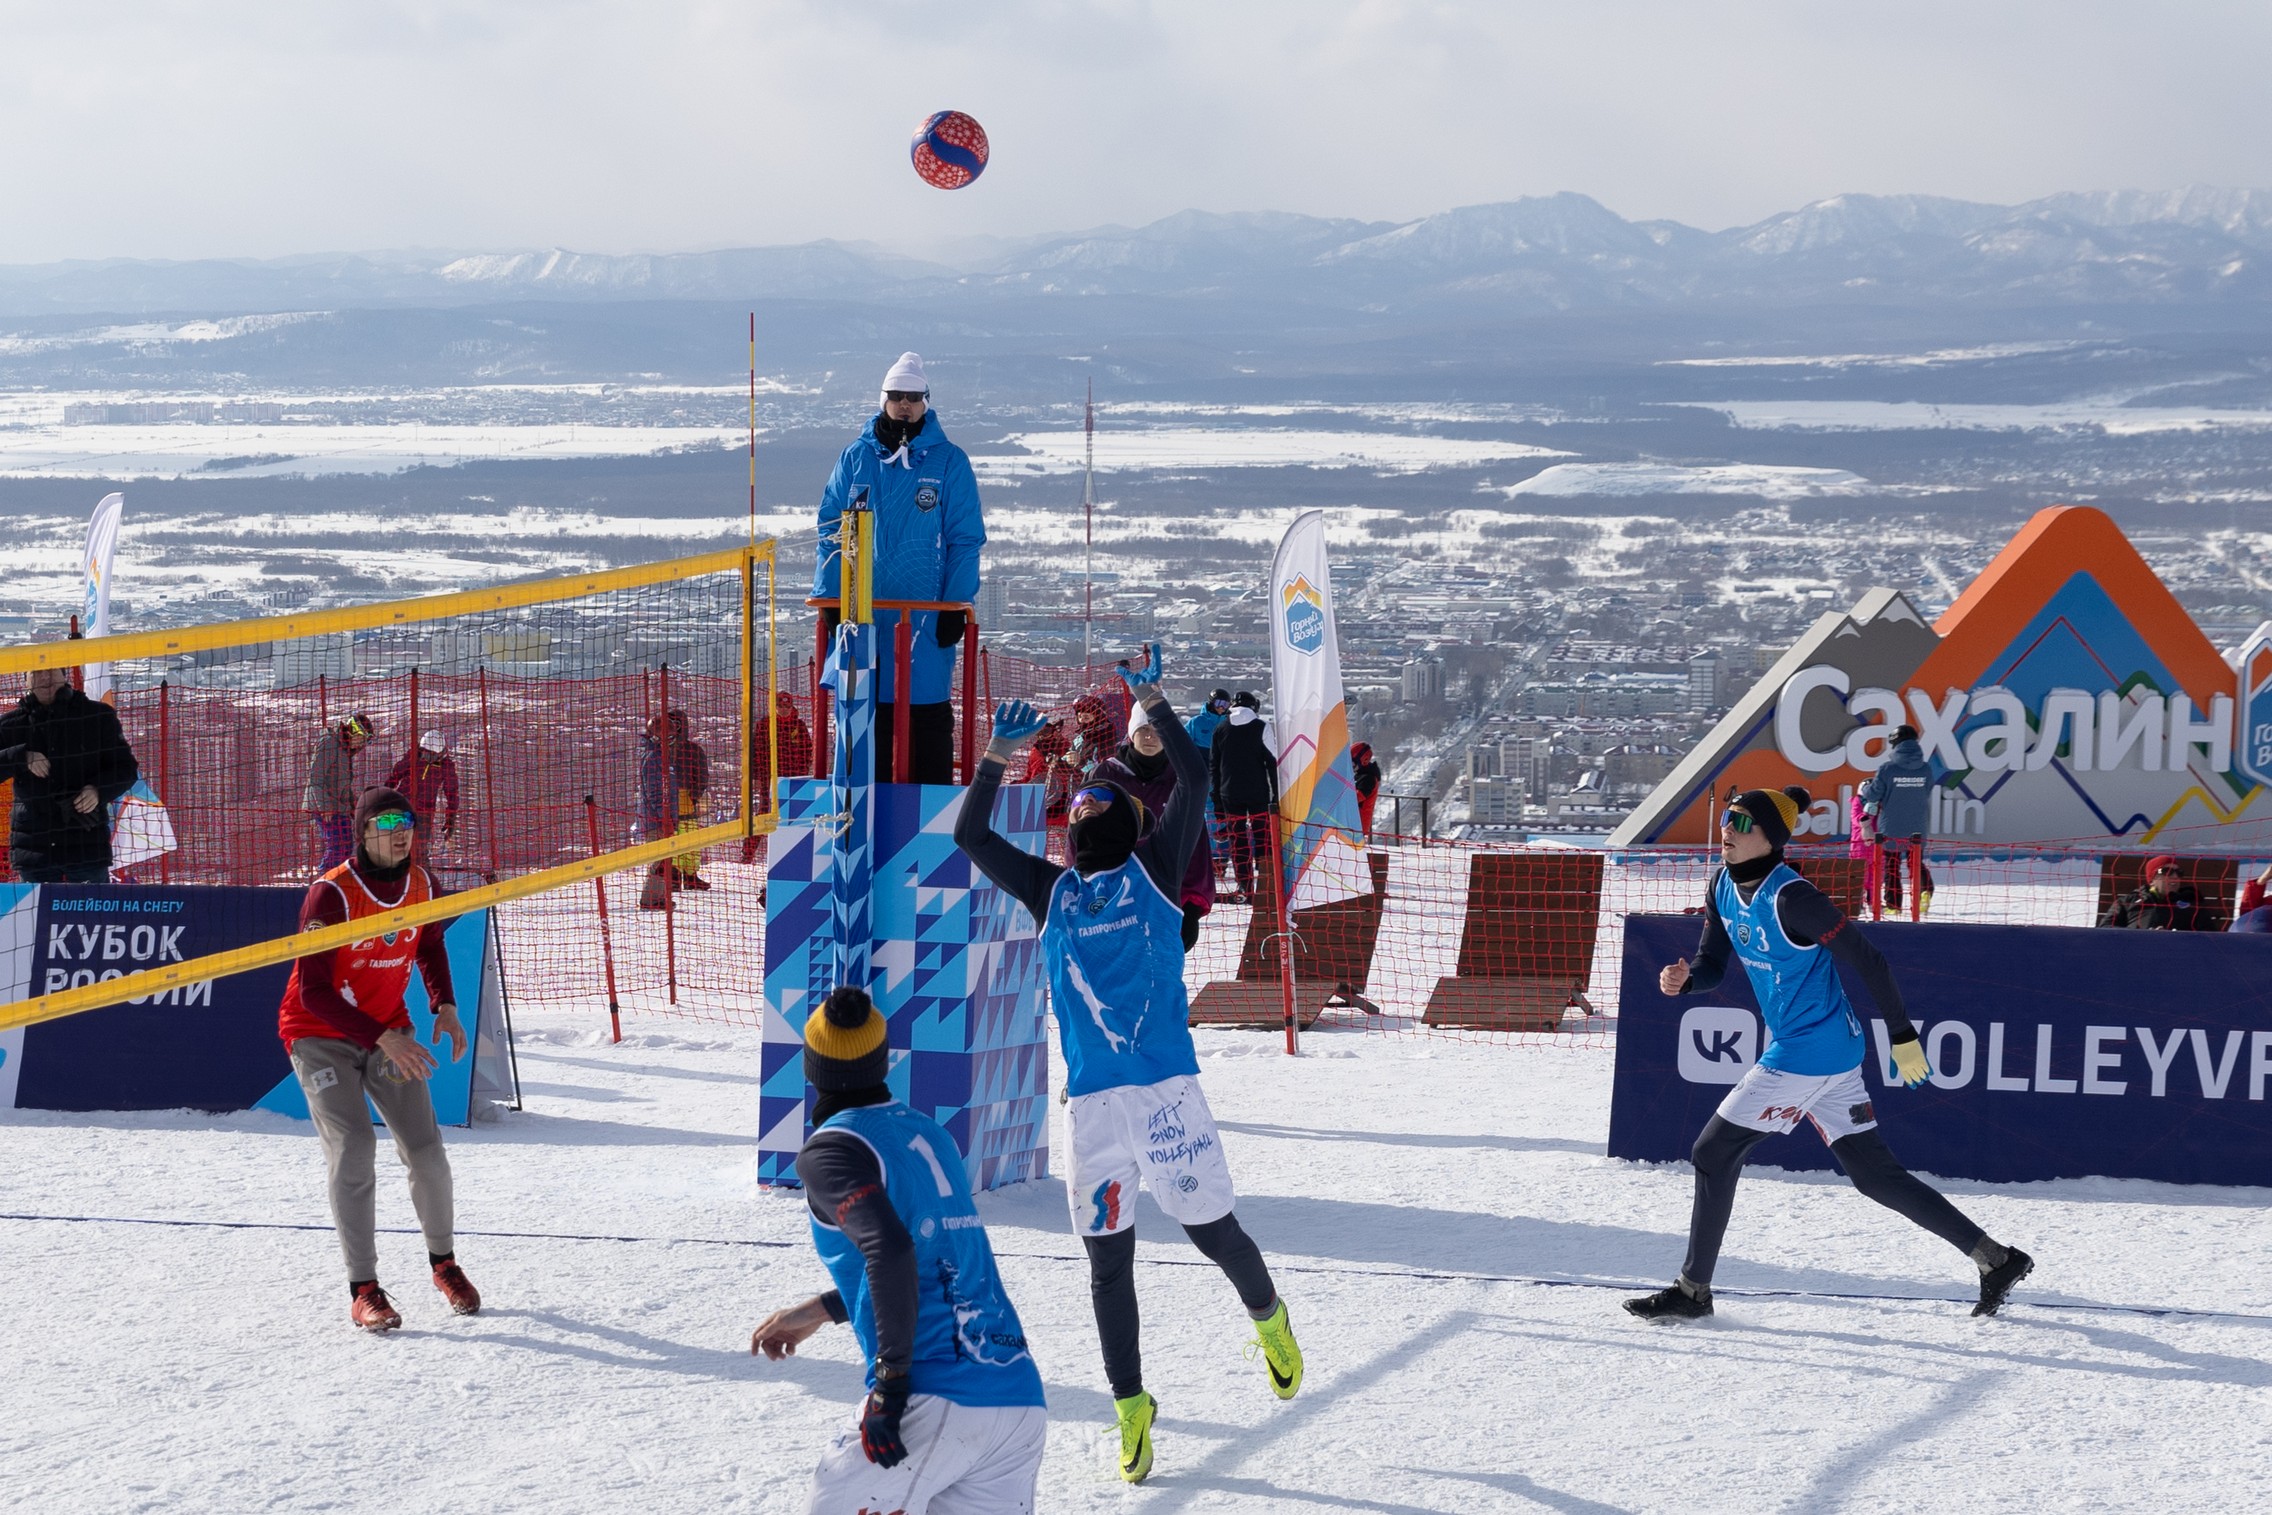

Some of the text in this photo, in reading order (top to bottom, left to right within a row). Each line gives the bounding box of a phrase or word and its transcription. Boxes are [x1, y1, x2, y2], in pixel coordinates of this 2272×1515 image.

[1775, 664, 2234, 773] Сахалин
[52, 898, 184, 913] ВОЛЕЙБОЛ НА СНЕГУ
[1117, 877, 1135, 907] 2
[47, 923, 186, 961] КУБОК
[1078, 915, 1139, 938] ГАЗПРОМБАНК
[1756, 926, 1770, 952] 3
[1692, 1029, 1743, 1064] VK
[1146, 1133, 1213, 1167] VOLLEYBALL
[1150, 1124, 1185, 1144] SNOW
[907, 1133, 953, 1197] 1
